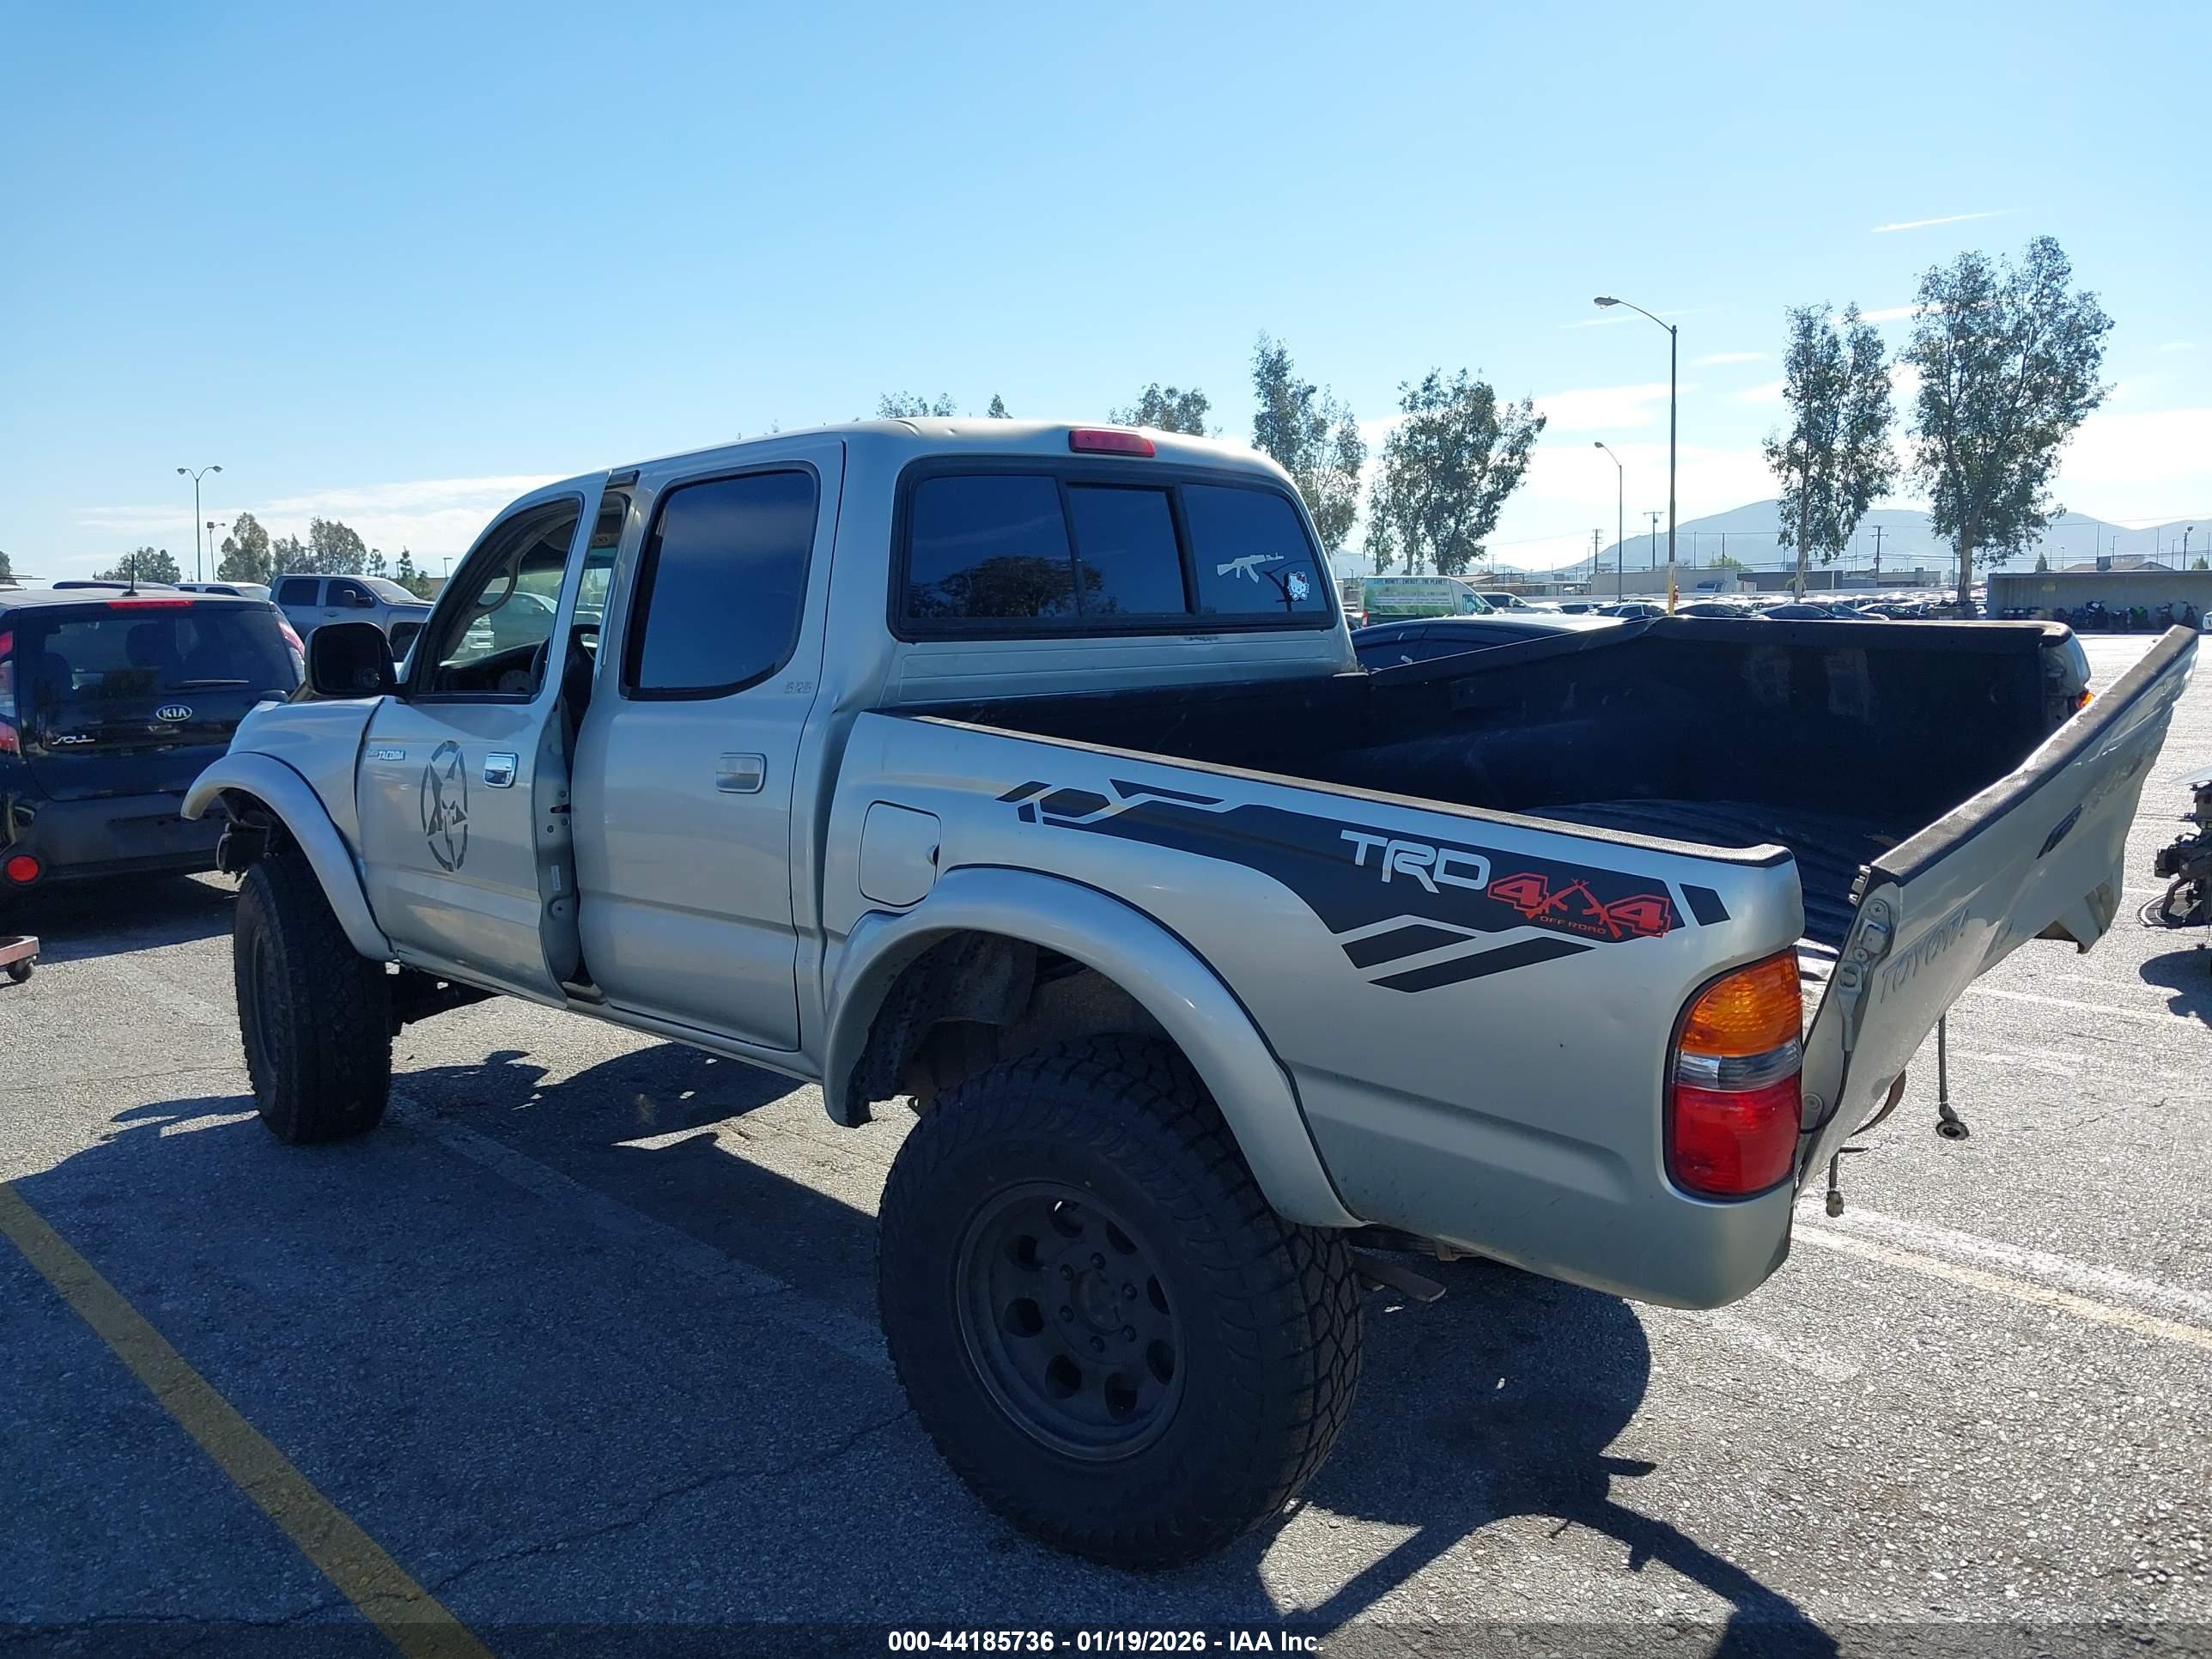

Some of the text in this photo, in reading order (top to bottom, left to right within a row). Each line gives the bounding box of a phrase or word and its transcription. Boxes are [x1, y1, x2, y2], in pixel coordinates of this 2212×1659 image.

[1340, 830, 1491, 894] TRD
[1540, 915, 1607, 935] OFF ROAD
